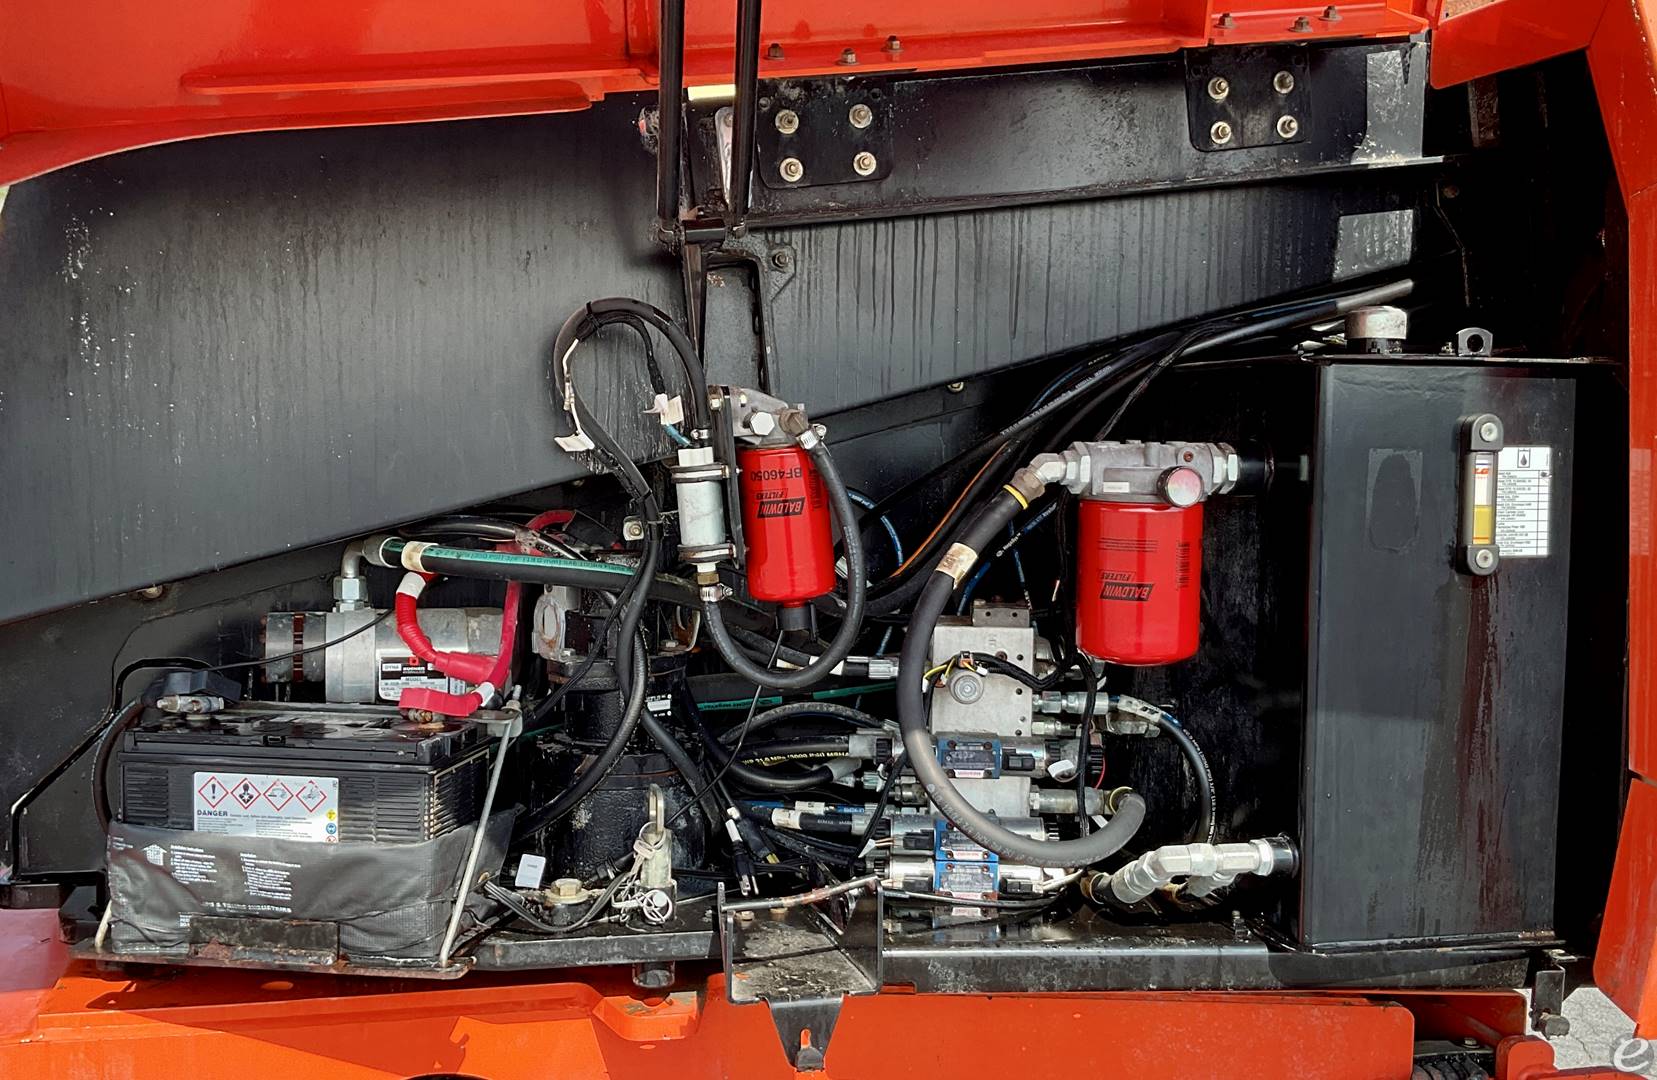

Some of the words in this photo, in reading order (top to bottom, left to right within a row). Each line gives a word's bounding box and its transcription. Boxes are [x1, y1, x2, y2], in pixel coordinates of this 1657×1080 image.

[750, 468, 802, 481] BF46050
[759, 501, 802, 516] BALDWIN
[1100, 572, 1131, 582] FILTERS
[1103, 585, 1150, 599] BALDWIN
